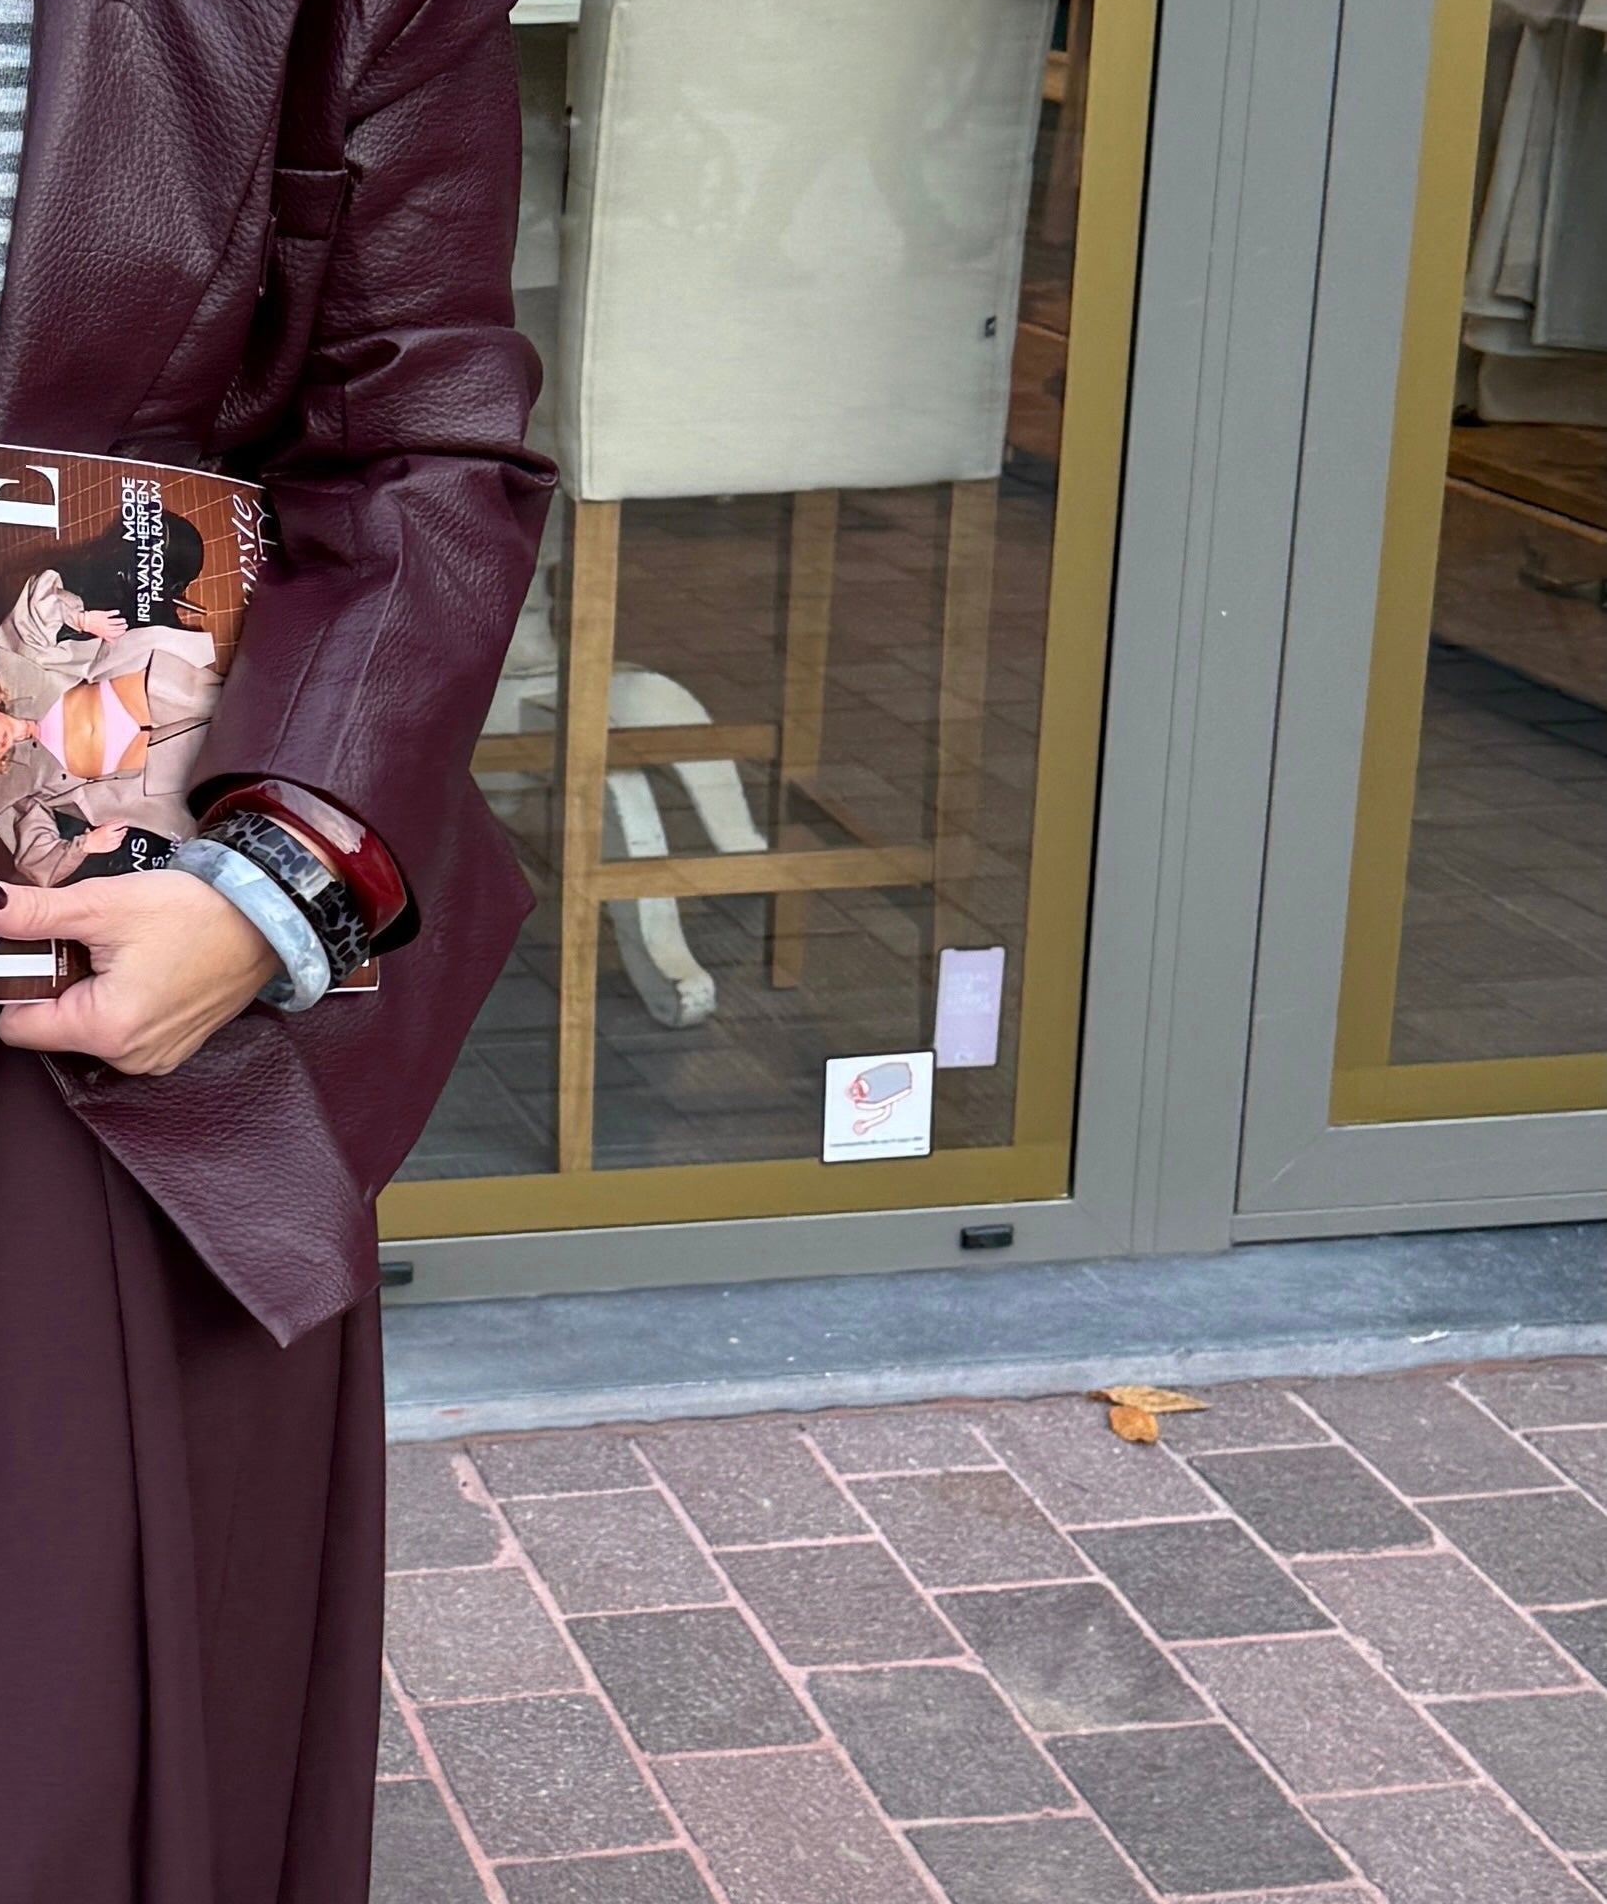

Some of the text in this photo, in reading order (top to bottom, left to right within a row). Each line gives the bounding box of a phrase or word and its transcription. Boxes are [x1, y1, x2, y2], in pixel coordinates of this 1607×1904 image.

[121, 476, 136, 541] MODE
[149, 480, 163, 536] RAUW
[136, 479, 151, 622] IRIS VAN HERPEN
